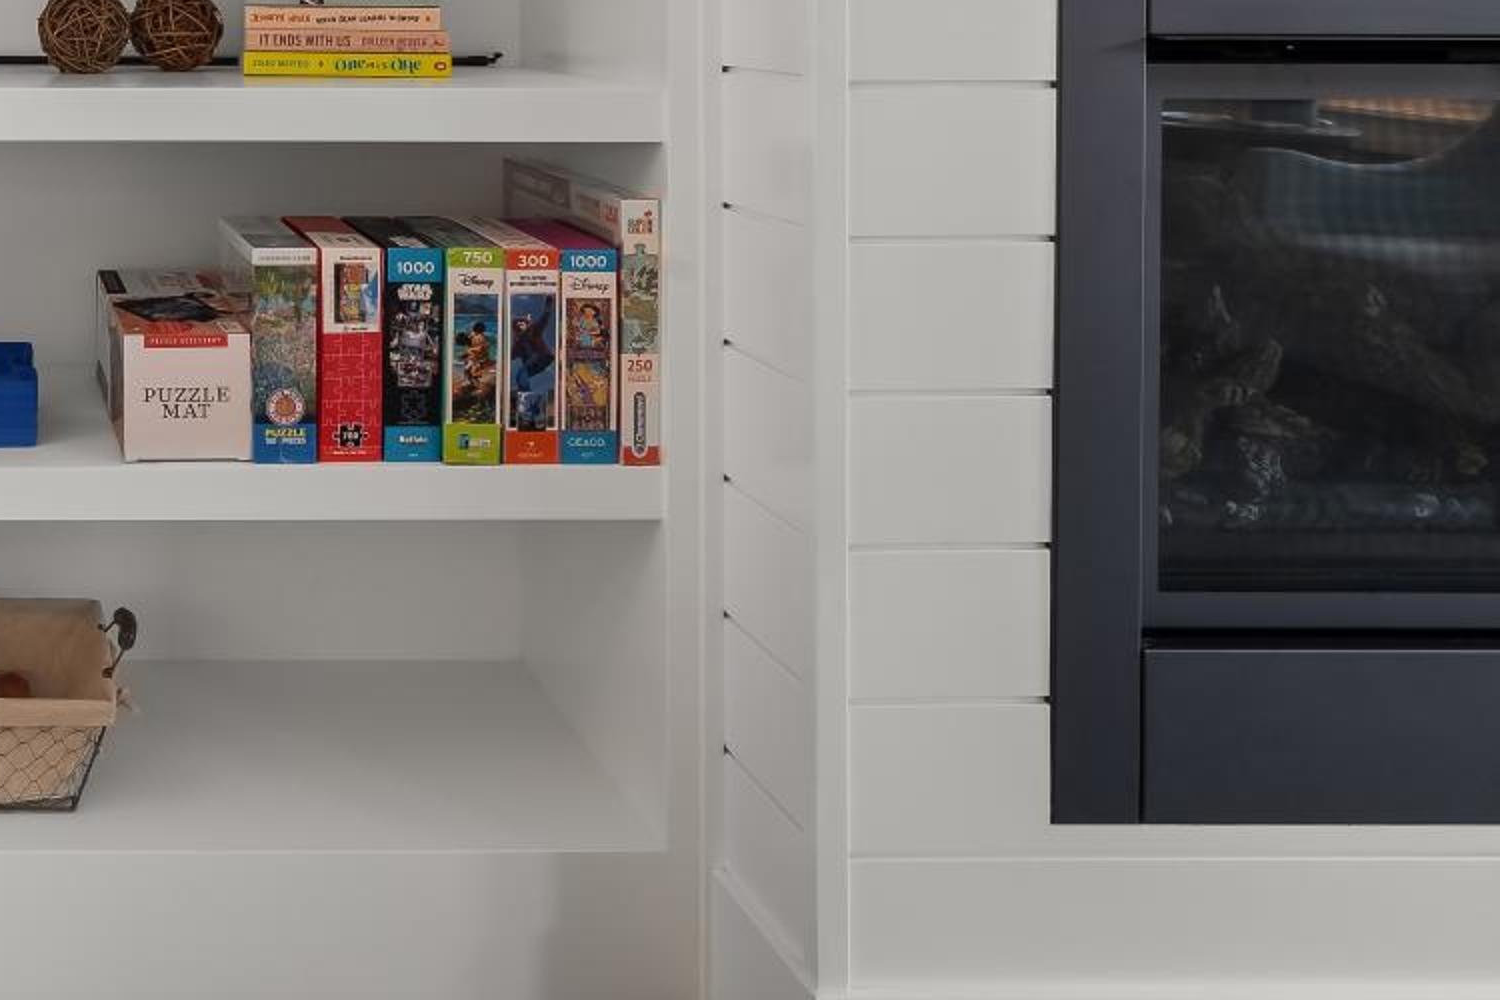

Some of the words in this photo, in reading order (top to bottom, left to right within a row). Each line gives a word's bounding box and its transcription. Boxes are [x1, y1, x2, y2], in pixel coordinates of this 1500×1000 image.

[259, 34, 270, 47] IT
[273, 34, 302, 47] ENDS
[305, 34, 333, 47] WITH
[335, 34, 351, 47] US
[463, 251, 493, 264] 750
[517, 254, 549, 267] 300
[570, 254, 606, 267] 1000
[396, 261, 435, 275] 1000
[458, 273, 495, 288] Disney
[570, 276, 610, 294] Disney
[627, 359, 653, 371] 250
[143, 387, 231, 403] PUZZLE
[161, 404, 212, 419] MAT
[265, 428, 307, 438] PUZZLE
